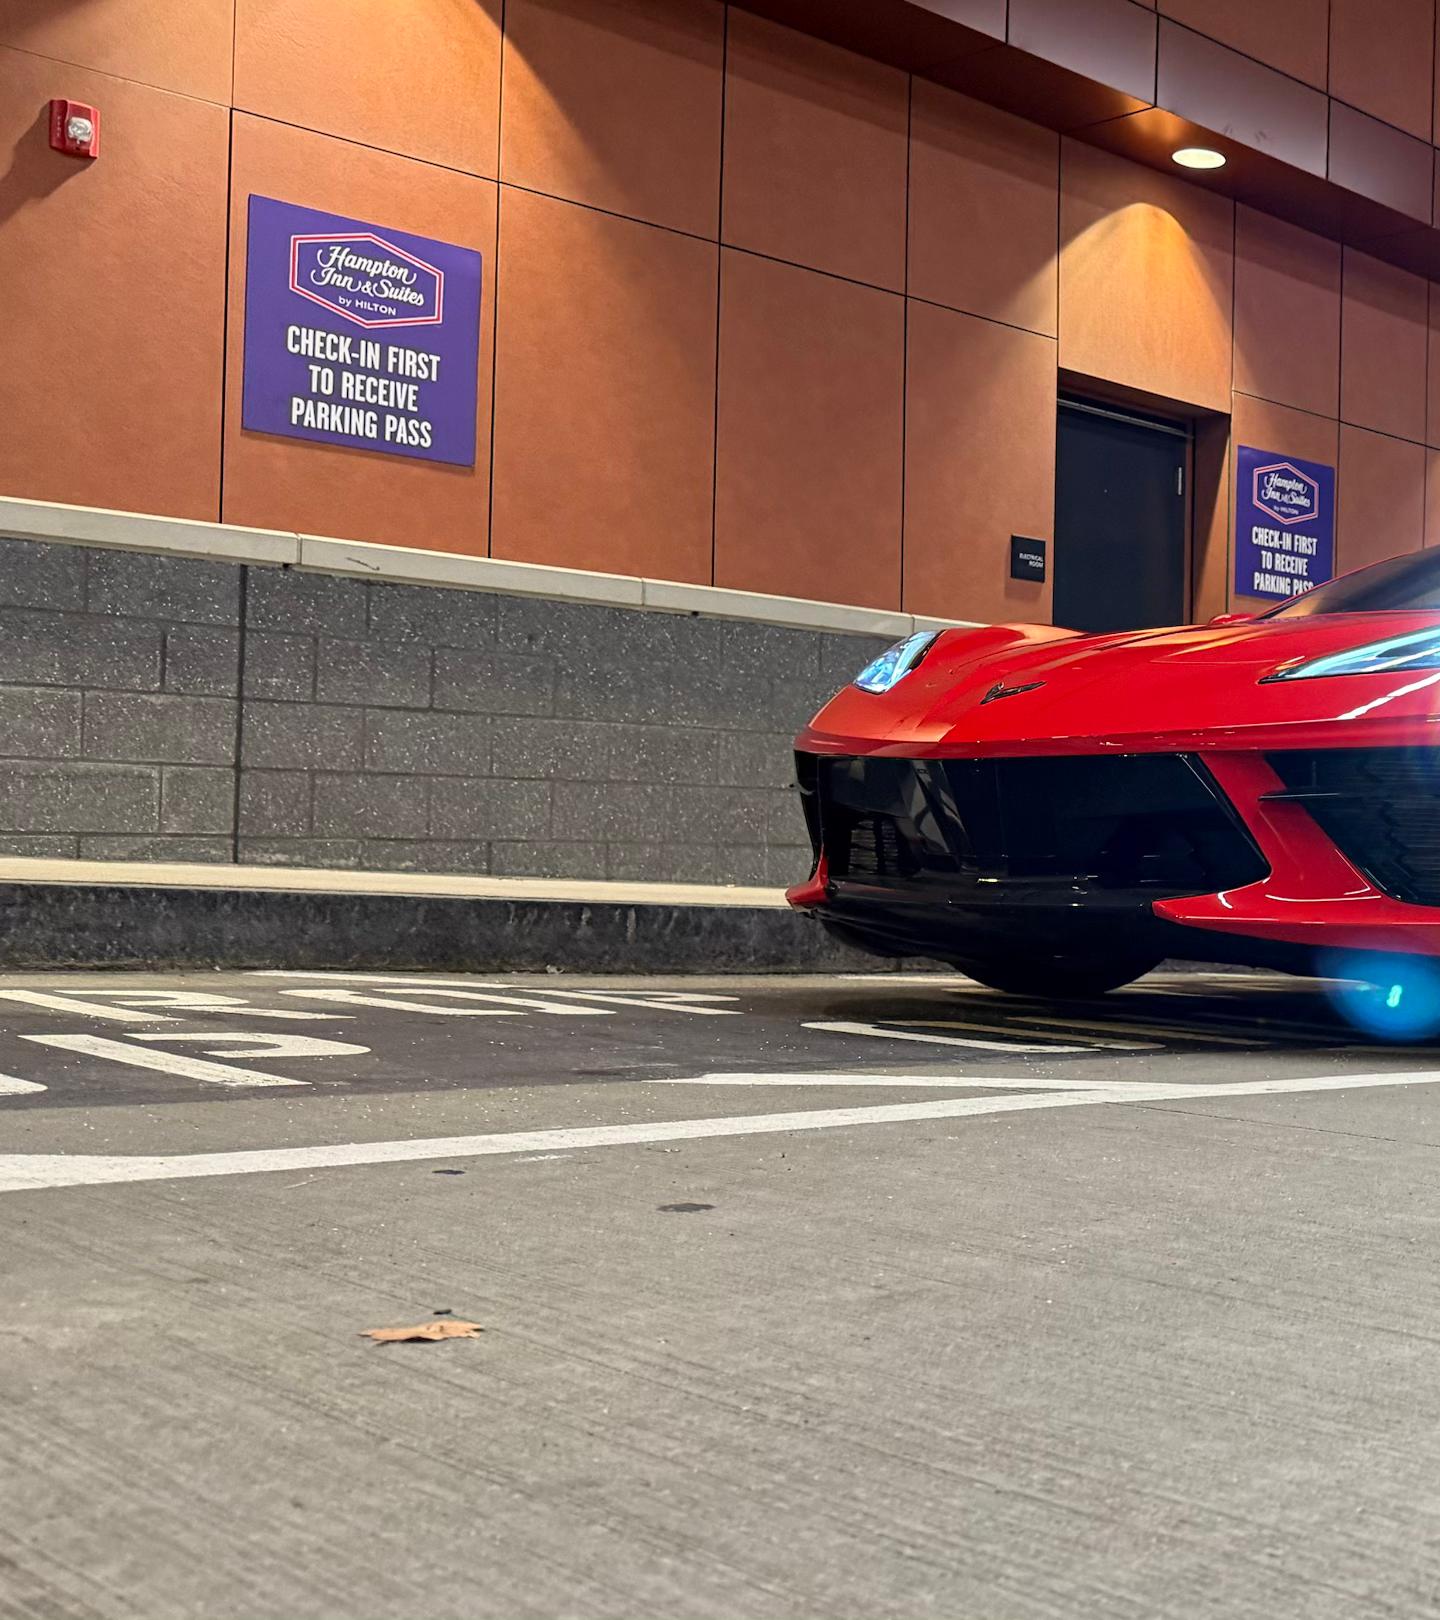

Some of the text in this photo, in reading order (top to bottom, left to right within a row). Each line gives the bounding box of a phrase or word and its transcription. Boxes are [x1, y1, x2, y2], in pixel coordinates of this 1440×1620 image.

[317, 246, 417, 285] Hampton
[311, 267, 362, 292] Inn
[373, 279, 425, 307] Suites
[338, 296, 397, 316] by HILTON
[286, 325, 441, 382] CHECK-IN FIRST
[309, 364, 419, 412] TO RECEIVE
[291, 397, 432, 448] PARKING PASS
[1264, 473, 1308, 494] Hampton
[1252, 526, 1318, 556] CHECK-IN FIRST
[1261, 550, 1309, 576] TO RECEIVE
[1254, 572, 1291, 596] PARKING
